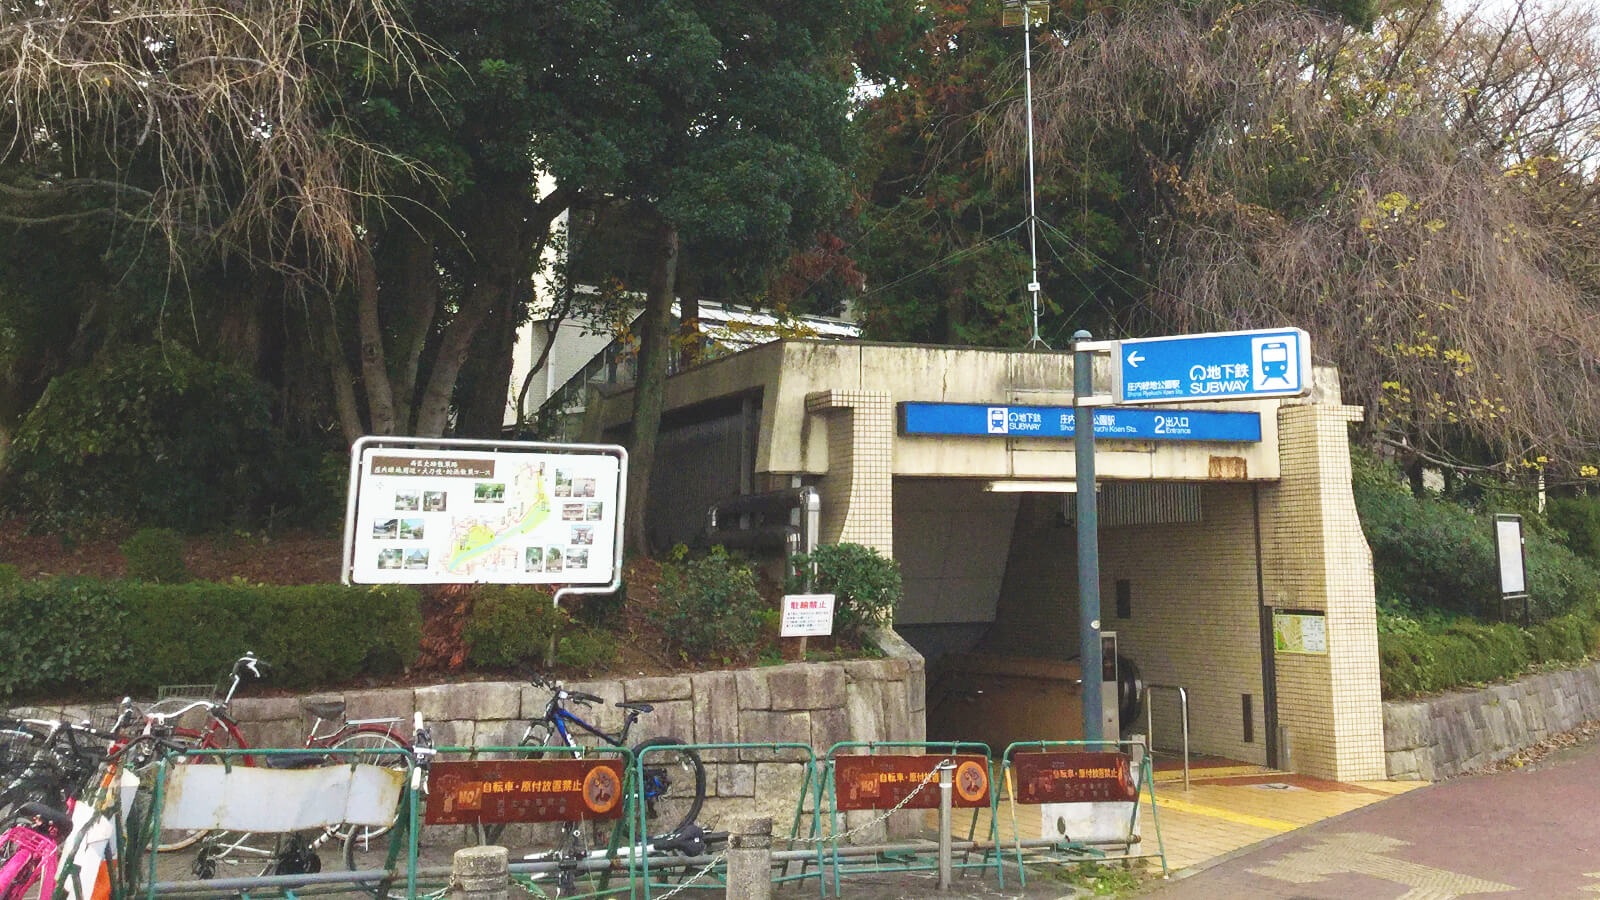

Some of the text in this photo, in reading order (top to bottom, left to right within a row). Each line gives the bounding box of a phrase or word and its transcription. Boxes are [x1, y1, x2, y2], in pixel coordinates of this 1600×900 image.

[1206, 364, 1249, 379] 地下鉄
[1190, 380, 1249, 394] SUBWAY
[1019, 412, 1042, 423] 地下鉄
[1060, 413, 1116, 426] 庄内公園駅
[1009, 422, 1042, 431] SUBWAY
[1126, 425, 1138, 433] Sta.
[1154, 415, 1189, 434] 2 出入口
[483, 780, 582, 793] 自転車・原付放置禁止
